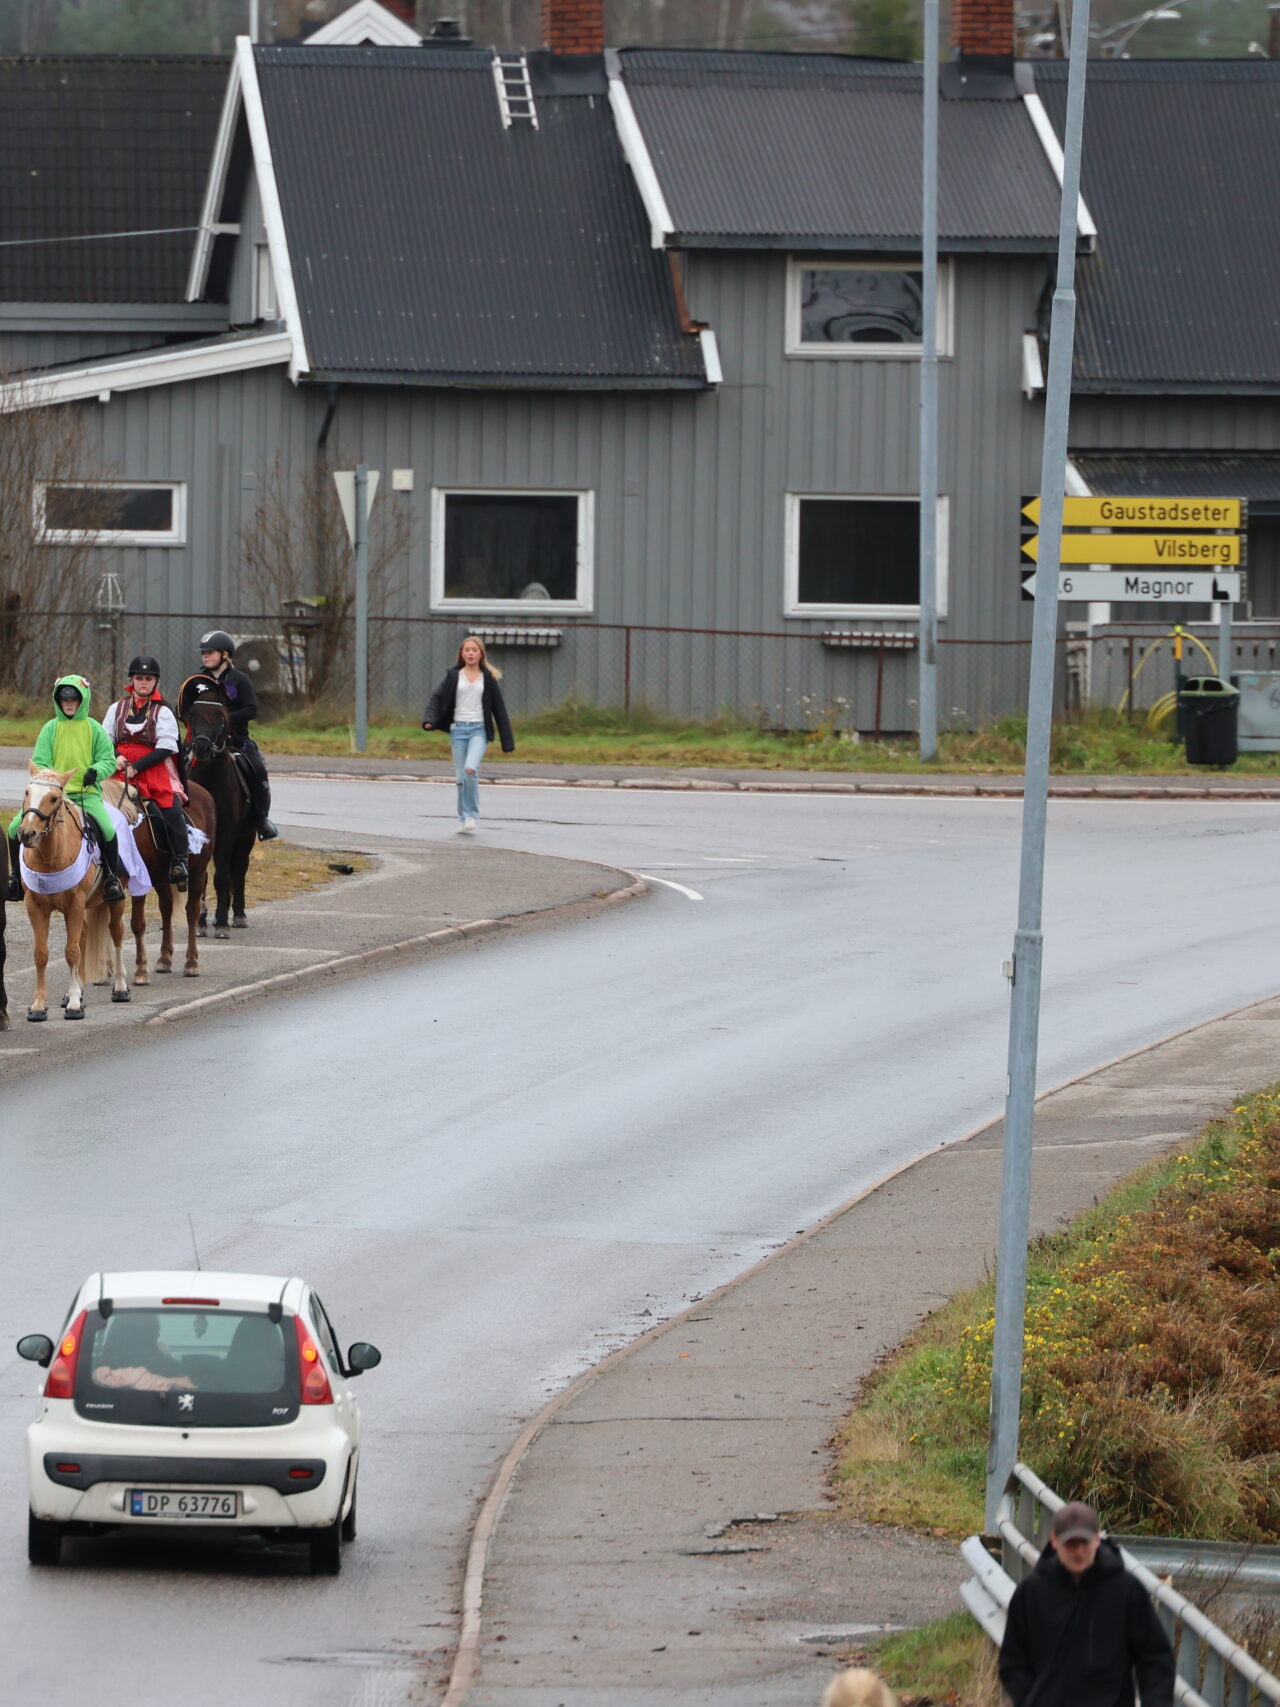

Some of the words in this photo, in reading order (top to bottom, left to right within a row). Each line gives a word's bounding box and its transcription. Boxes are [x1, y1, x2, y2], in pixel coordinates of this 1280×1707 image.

[1100, 502, 1230, 521] Gaustadseter
[1154, 539, 1231, 562] Vilsberg
[1058, 578, 1073, 594] .6
[1125, 576, 1193, 599] Magnor
[147, 1495, 170, 1511] DP
[178, 1496, 231, 1513] 63776
